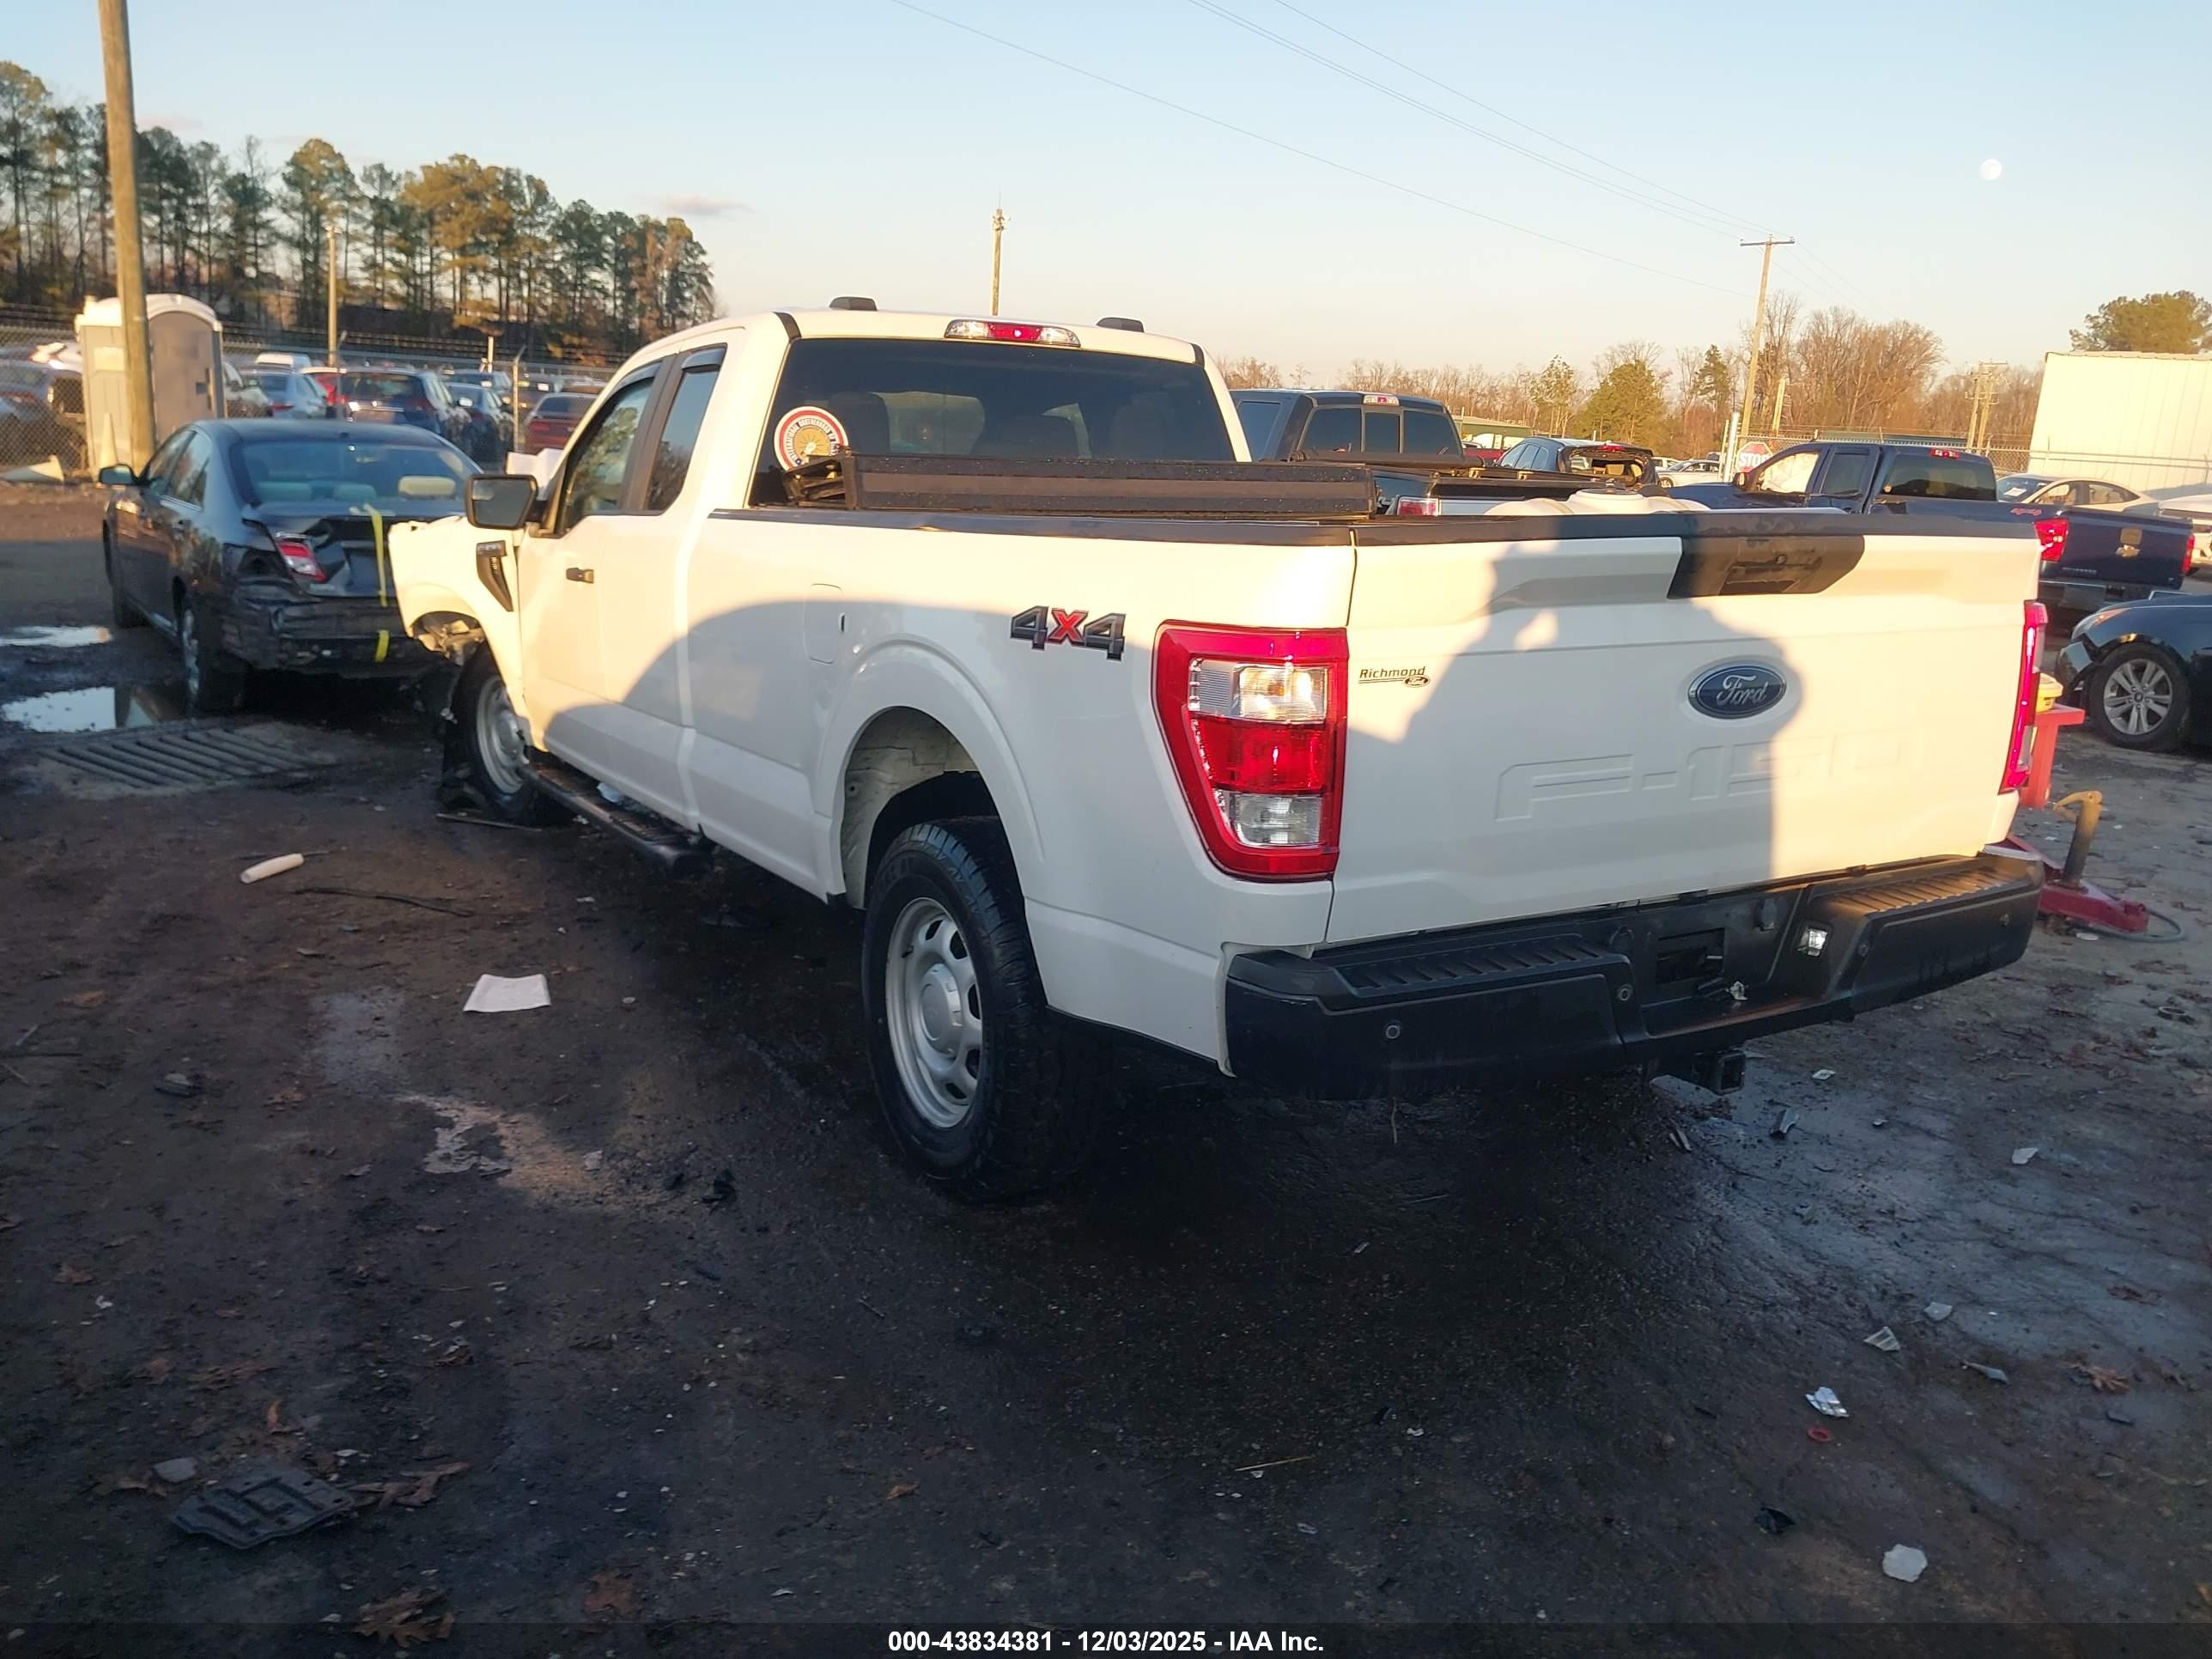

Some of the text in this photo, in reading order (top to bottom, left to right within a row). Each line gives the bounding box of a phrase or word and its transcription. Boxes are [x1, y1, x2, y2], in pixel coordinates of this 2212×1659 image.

[1359, 665, 1426, 678] Richmond
[1716, 674, 1767, 707] Ford
[1492, 727, 1921, 822] F-150
